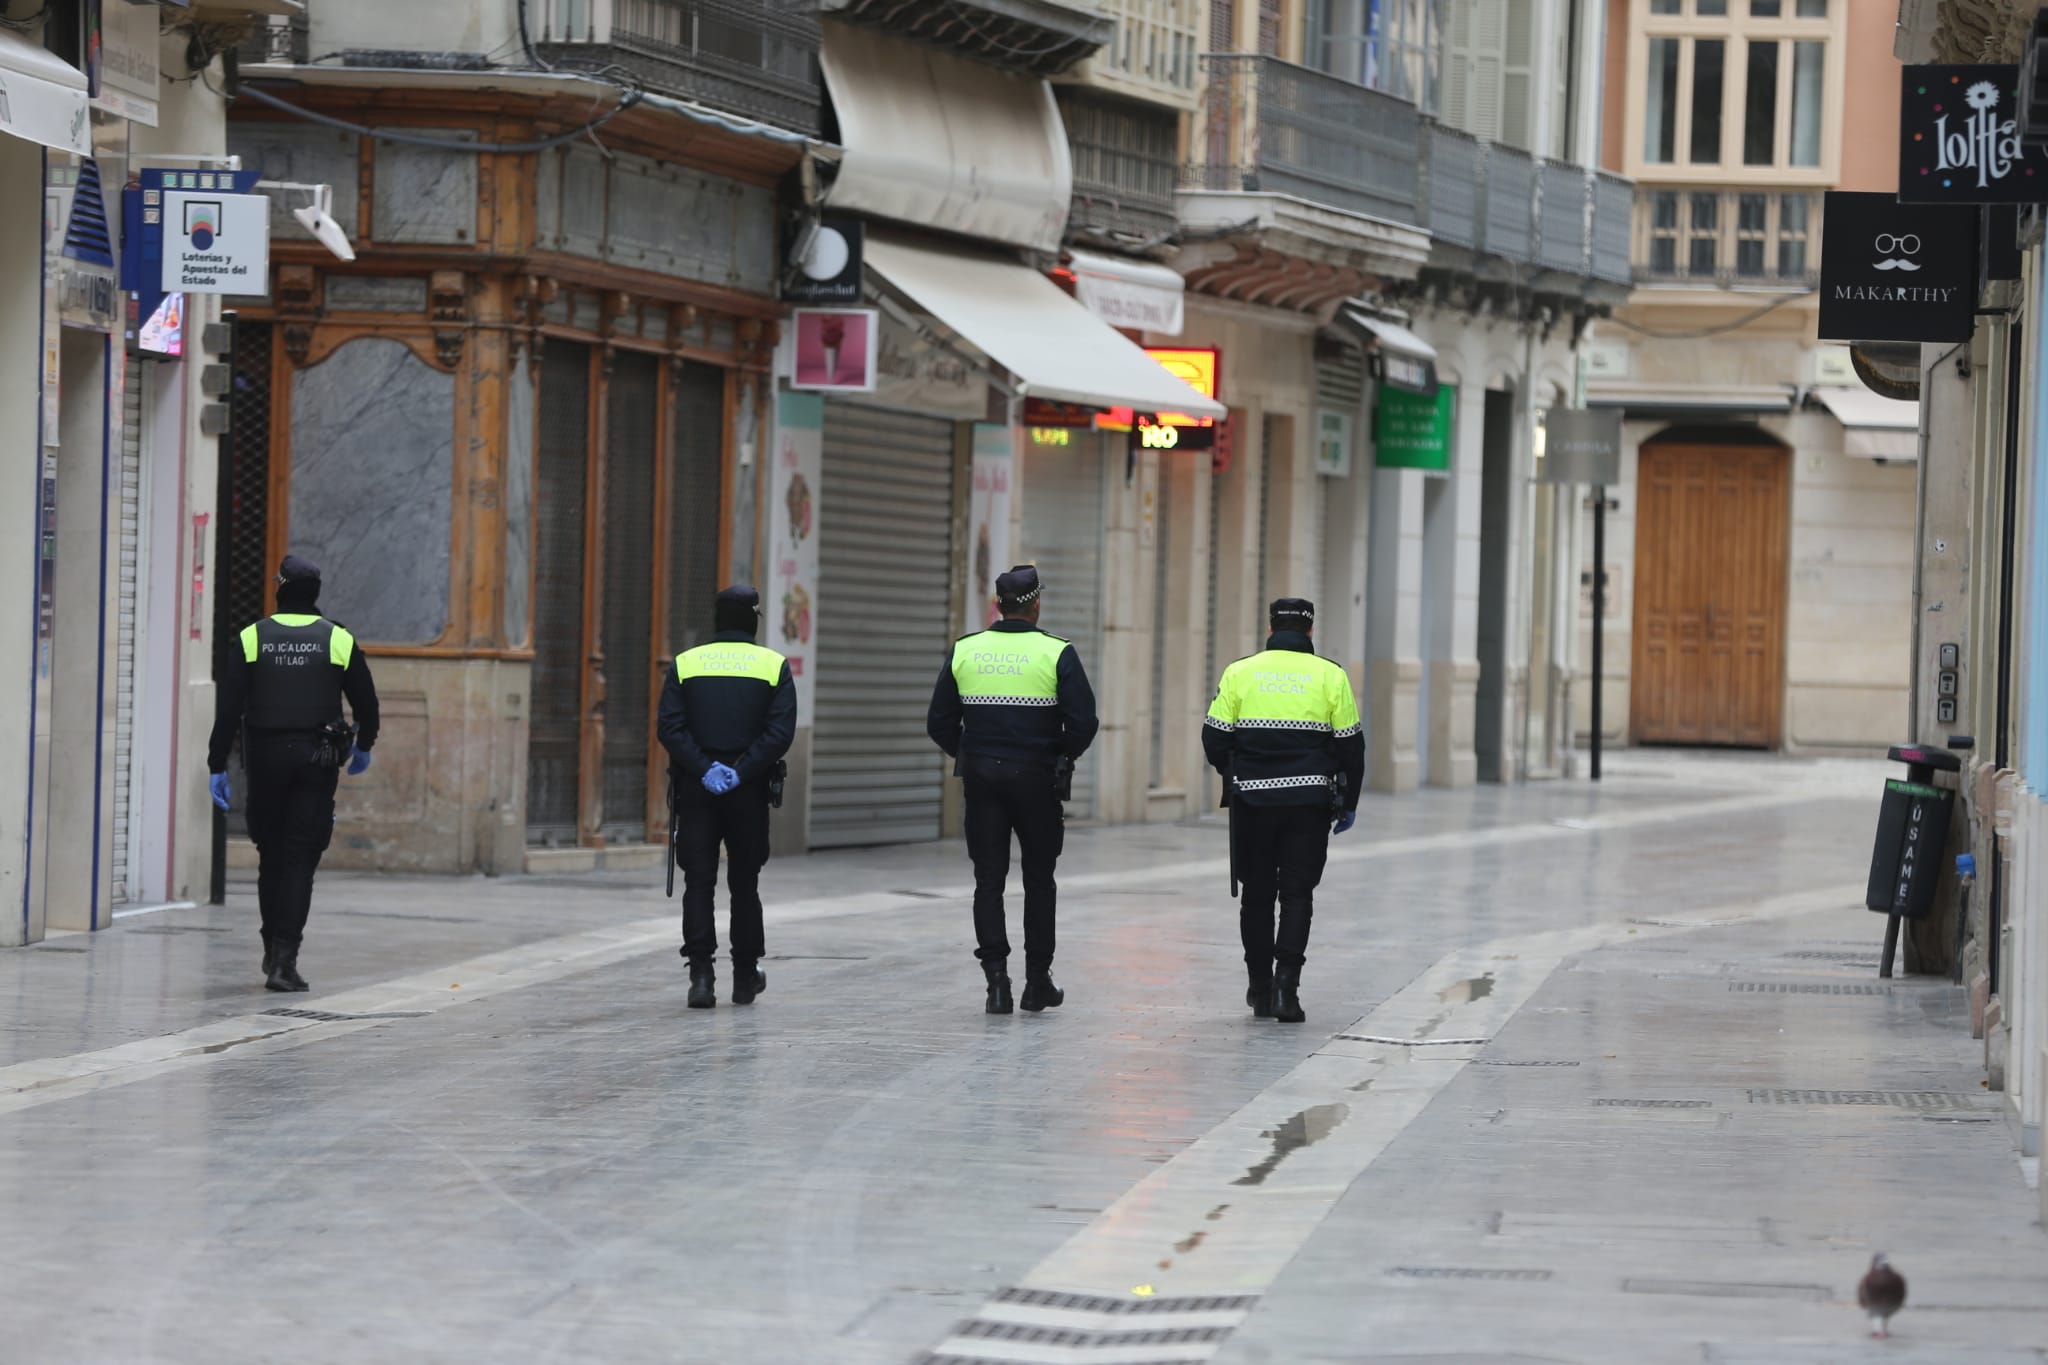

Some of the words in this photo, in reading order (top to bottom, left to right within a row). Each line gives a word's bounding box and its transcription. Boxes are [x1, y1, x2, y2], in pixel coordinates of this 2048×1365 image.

[1933, 81, 2024, 187] lolita
[225, 255, 232, 265] y
[182, 264, 229, 275] Apuestas
[231, 265, 247, 275] del
[181, 275, 217, 286] Estado
[1834, 285, 1951, 303] MAKARTHY
[295, 643, 324, 654] LOCAL
[974, 652, 1029, 664] POLICIA
[703, 661, 749, 672] LOCAL
[978, 664, 1024, 676] LOCAL
[1254, 671, 1313, 683] POLICIA
[1259, 682, 1306, 695] LOCAL
[1899, 804, 1922, 897] ÚSAME
